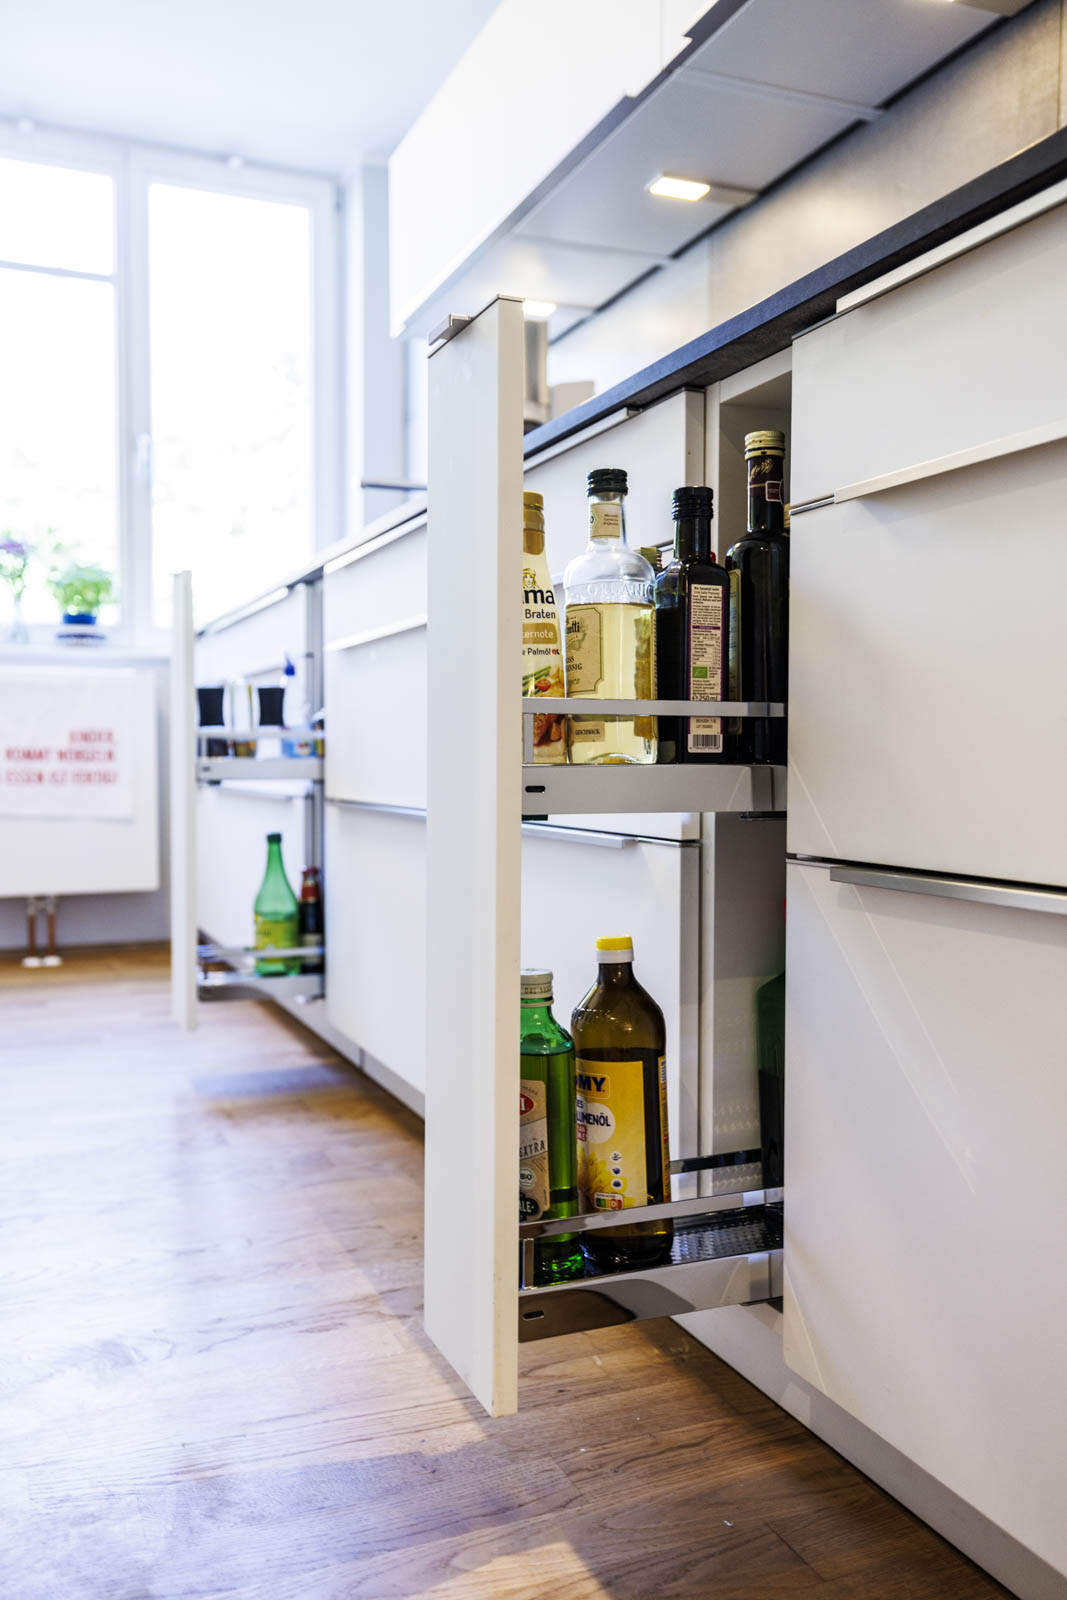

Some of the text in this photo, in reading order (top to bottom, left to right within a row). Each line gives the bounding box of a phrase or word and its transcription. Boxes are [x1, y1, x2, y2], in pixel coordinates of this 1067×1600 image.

[522, 589, 555, 605] ma
[525, 608, 556, 620] Braten
[527, 647, 551, 656] Palmöl
